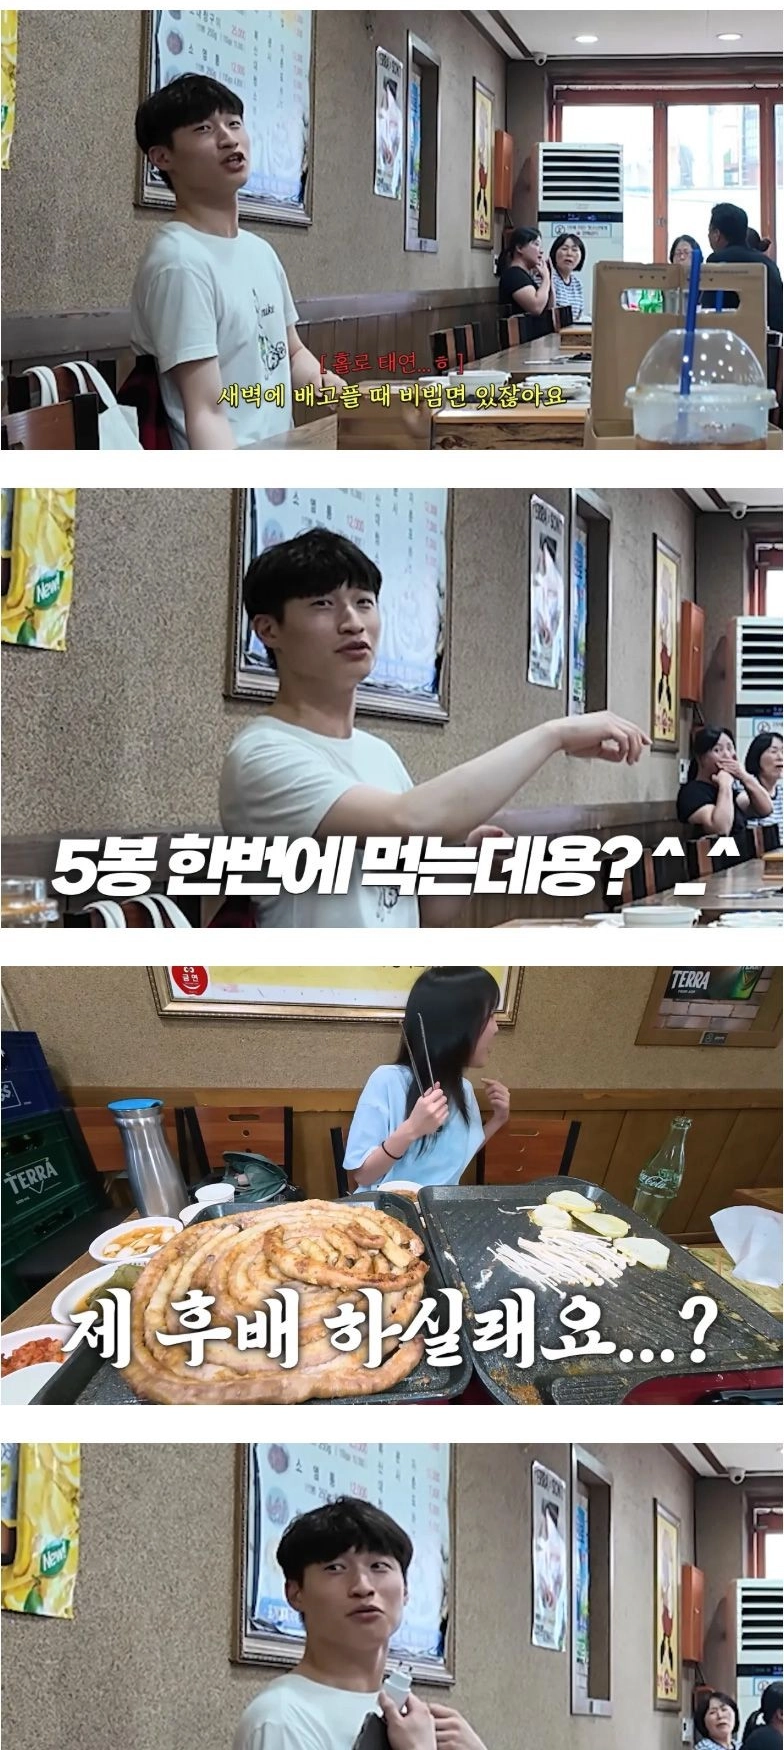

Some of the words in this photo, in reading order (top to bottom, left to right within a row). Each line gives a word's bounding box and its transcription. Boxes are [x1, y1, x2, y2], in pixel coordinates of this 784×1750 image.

[36, 571, 60, 602] New!
[671, 971, 710, 990] TERRA
[4, 1161, 58, 1195] TERRA
[43, 1539, 66, 1571] New!
